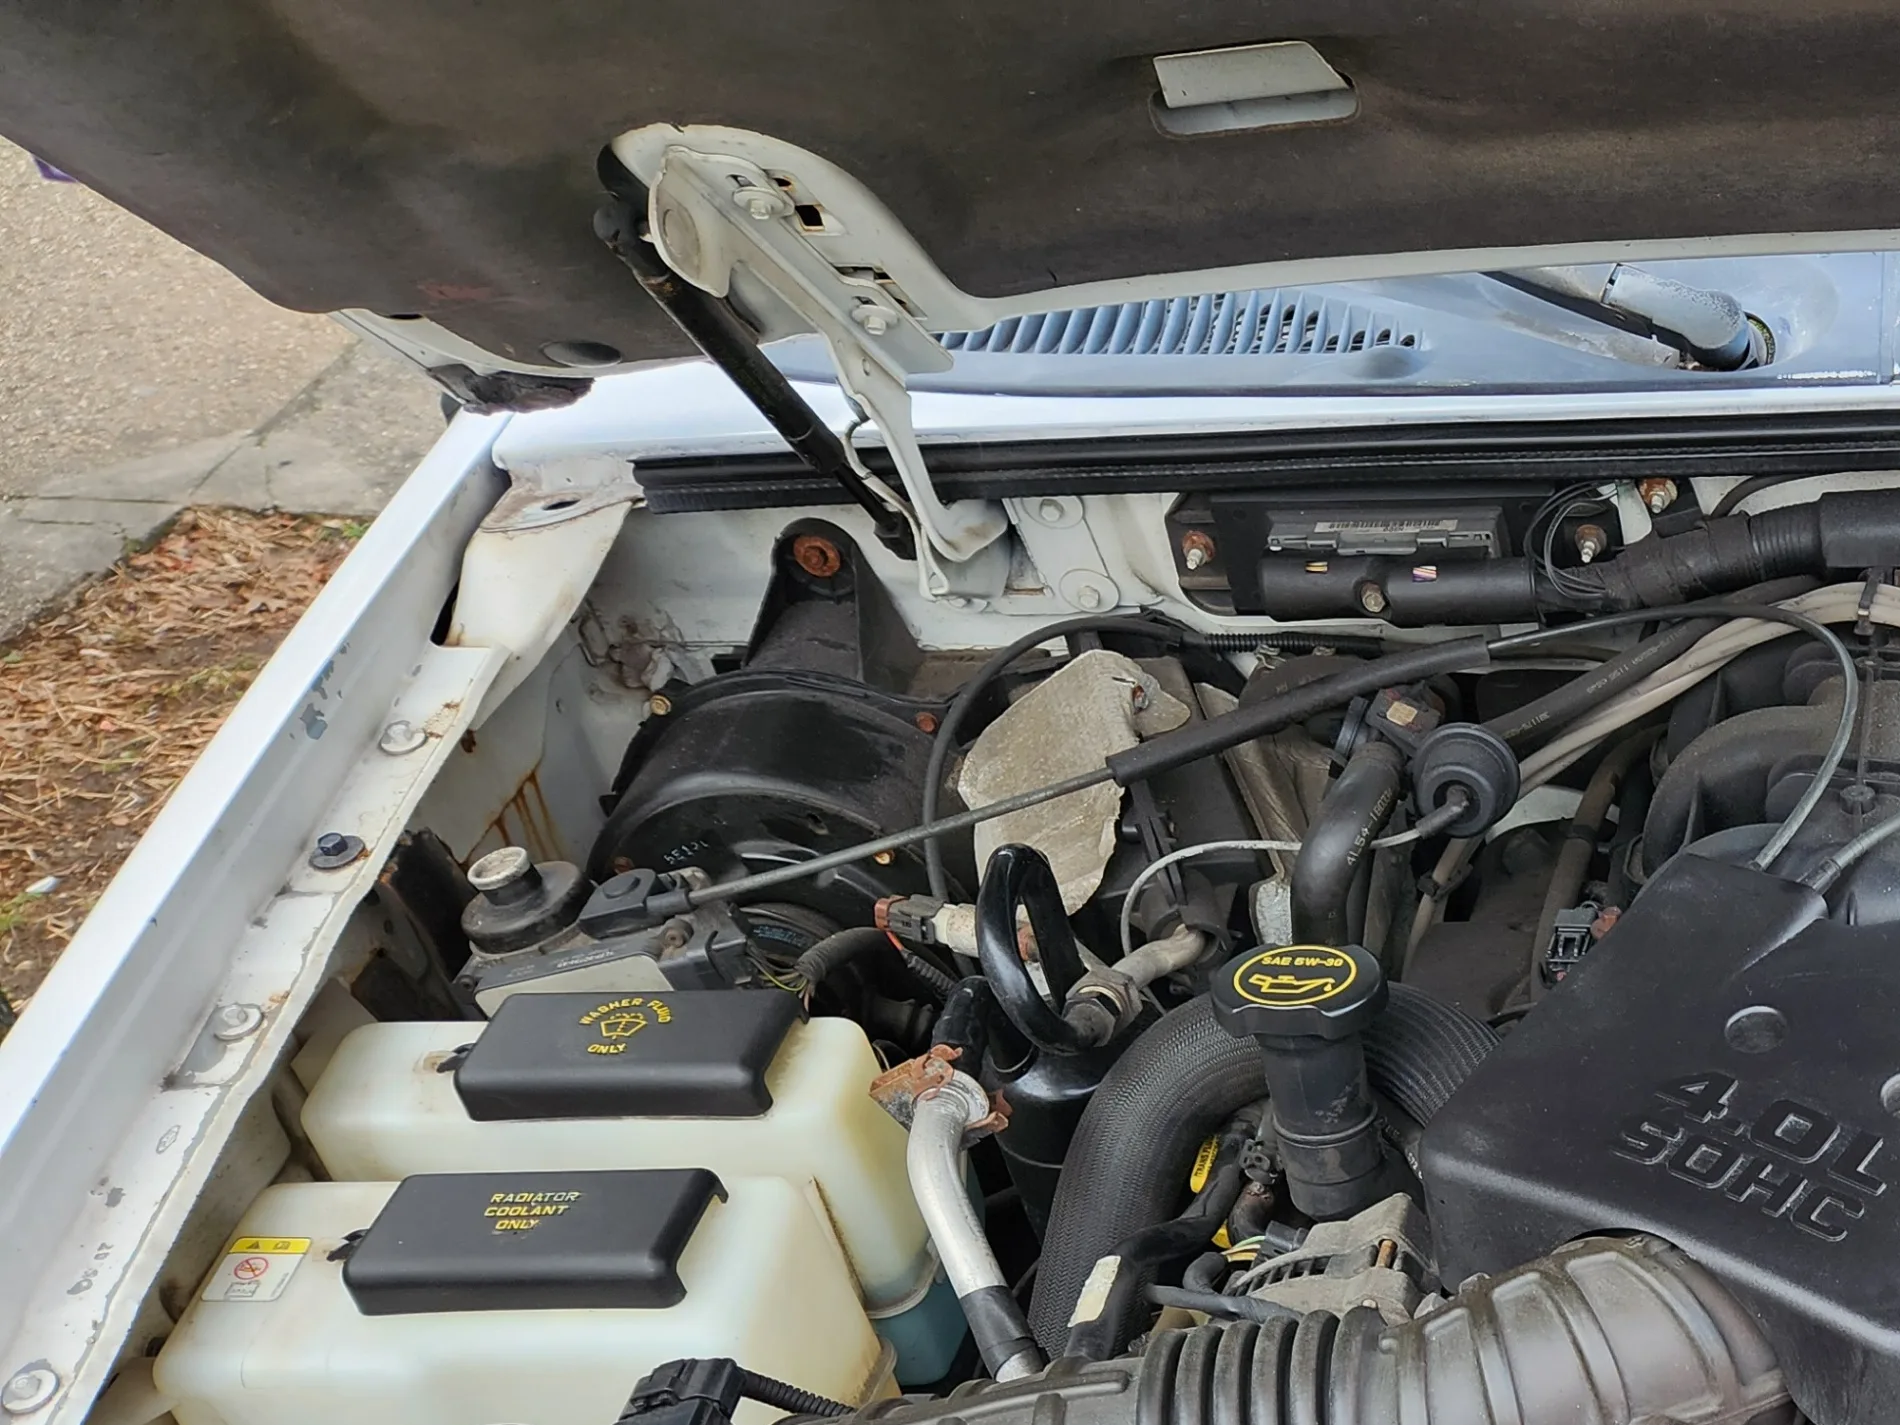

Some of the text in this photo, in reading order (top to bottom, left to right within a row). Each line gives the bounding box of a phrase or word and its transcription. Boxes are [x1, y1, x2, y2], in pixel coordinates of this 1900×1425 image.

[1261, 955, 1344, 967] SAE 5W-30
[579, 998, 673, 1026] WASHER FLUID
[587, 1043, 627, 1053] ONLY
[1654, 1072, 1887, 1197] 4.0L
[1611, 1117, 1865, 1243] SOHC
[490, 1192, 580, 1203] RADIATOR
[484, 1205, 569, 1216] COOLANT
[495, 1220, 540, 1230] ONLY
